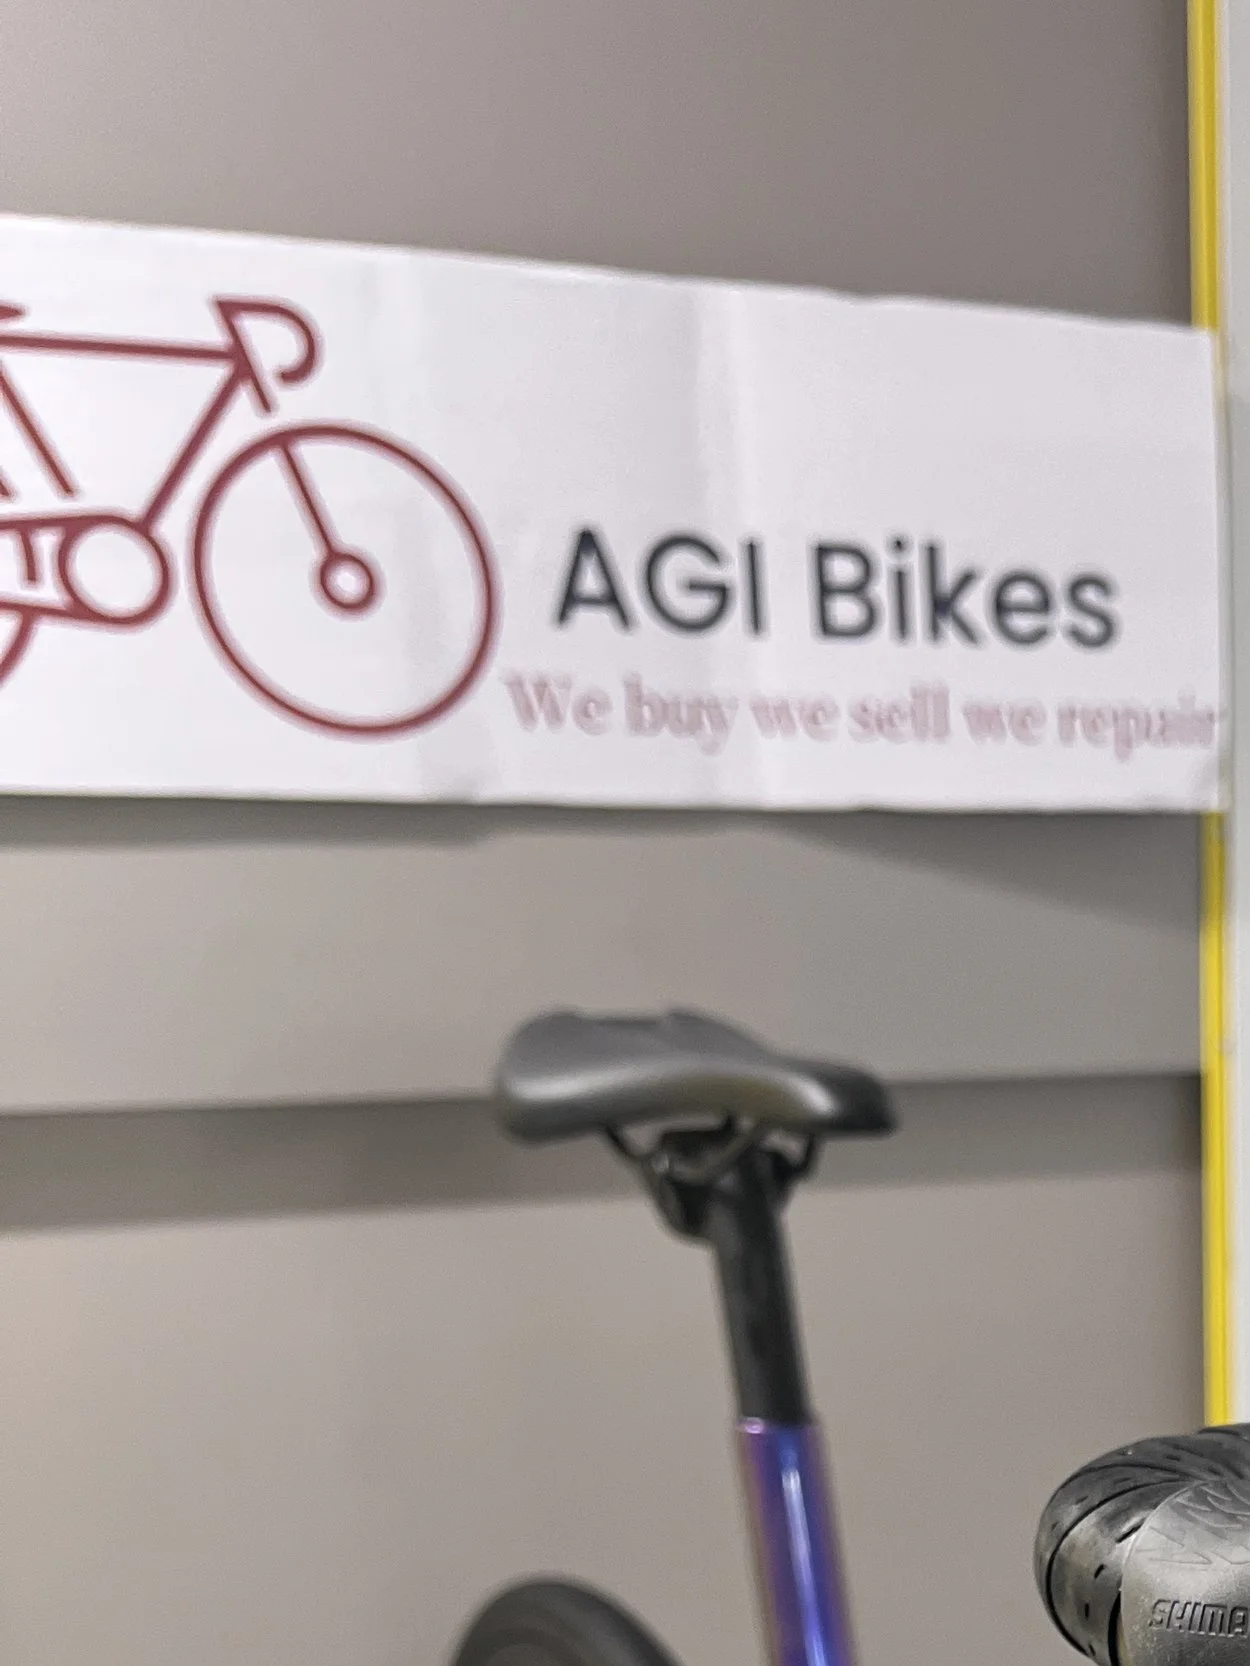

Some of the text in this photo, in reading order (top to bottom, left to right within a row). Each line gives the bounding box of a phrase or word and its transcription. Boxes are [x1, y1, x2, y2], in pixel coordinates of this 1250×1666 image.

[553, 527, 1120, 650] AGI Bikes
[503, 672, 612, 738] We
[622, 667, 737, 756] buy
[750, 694, 846, 742] we
[848, 684, 952, 745] sell
[962, 700, 1046, 746] we
